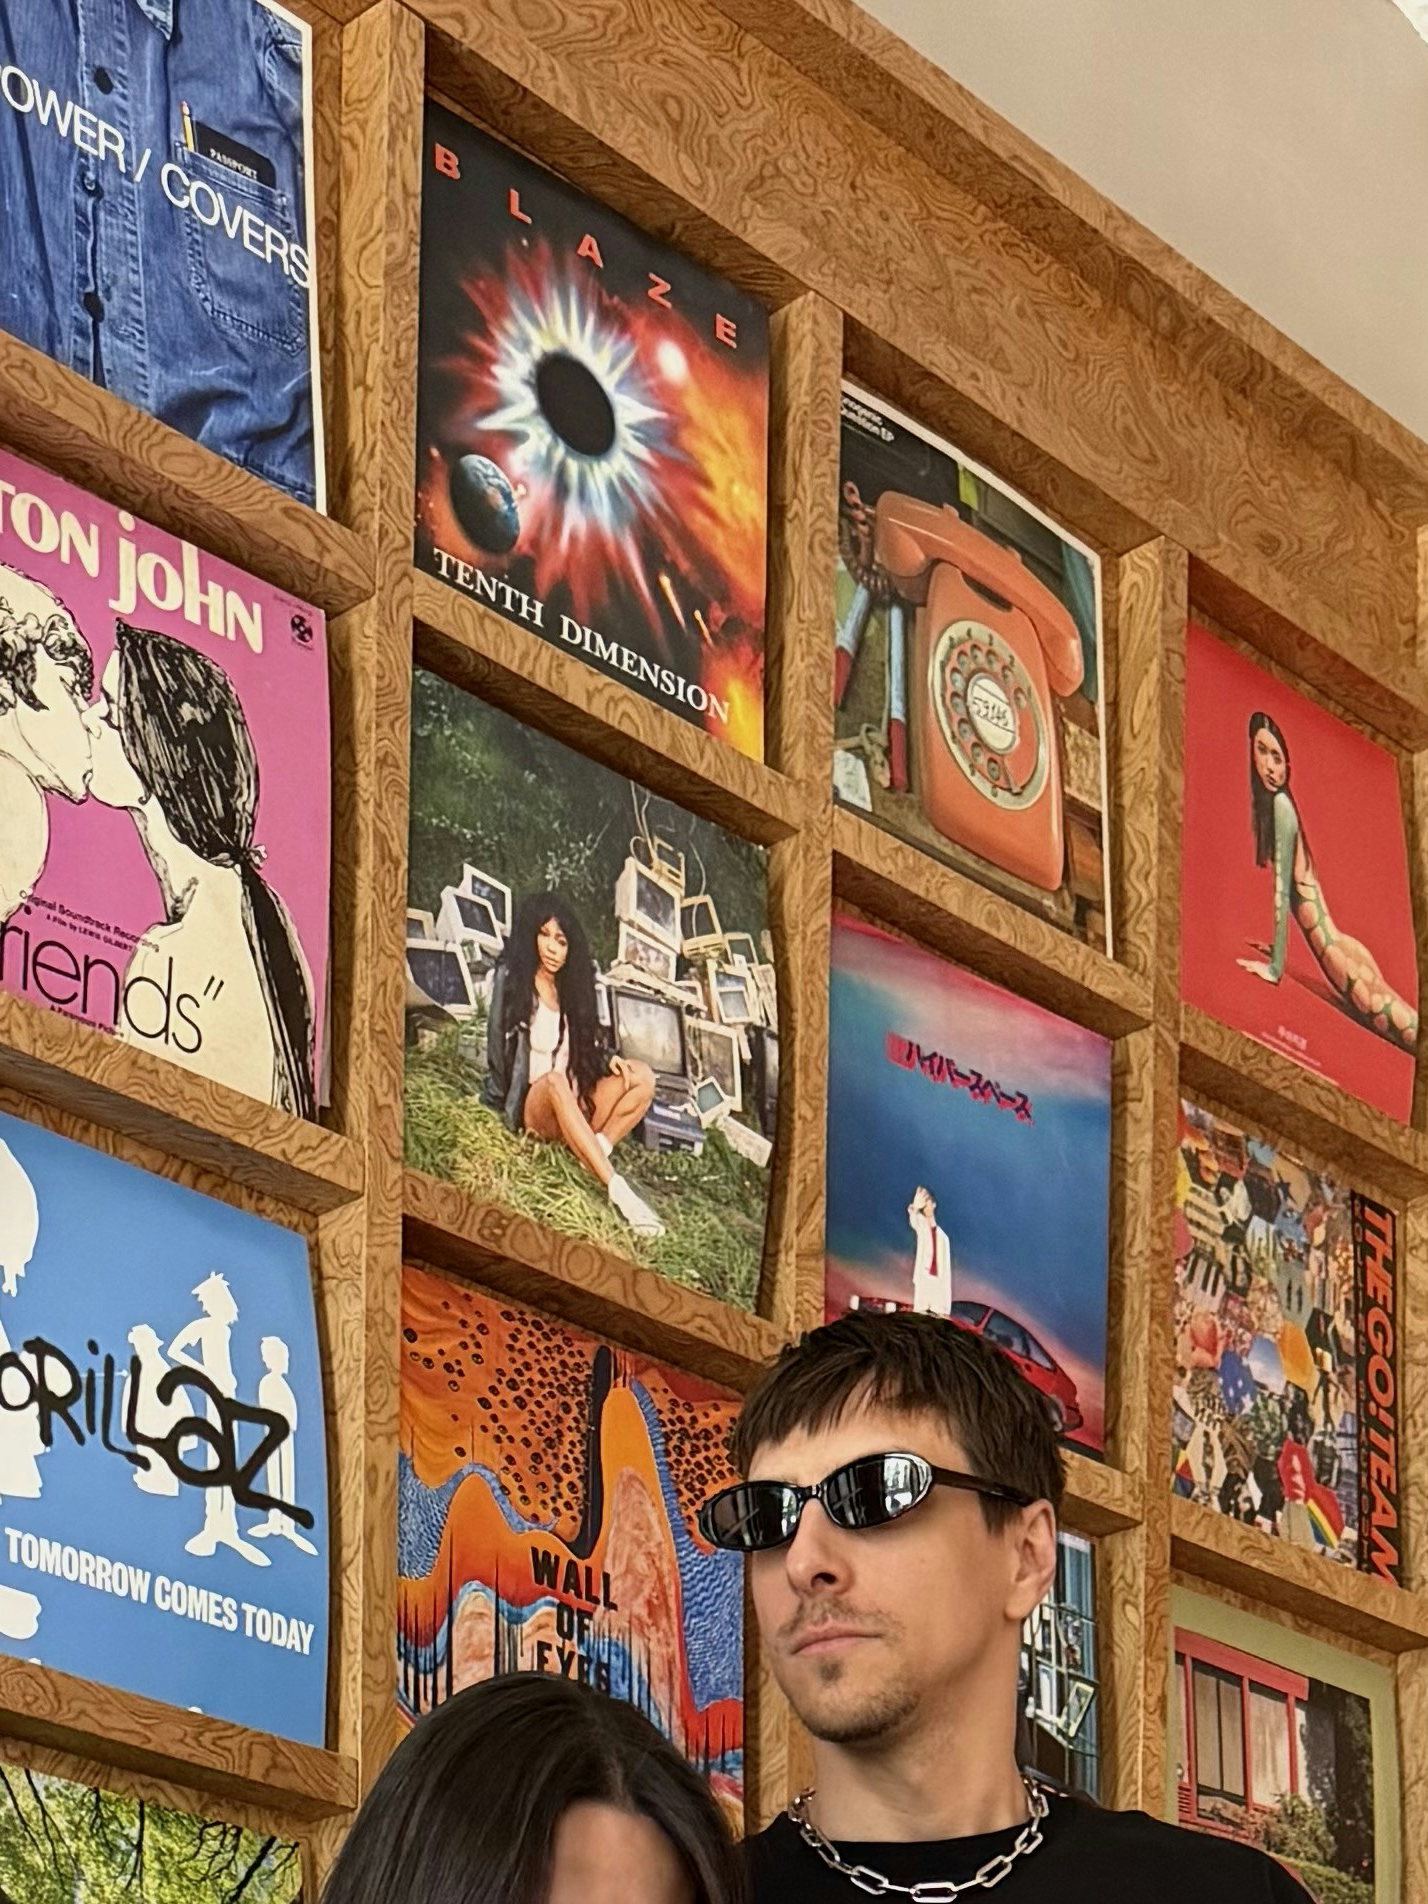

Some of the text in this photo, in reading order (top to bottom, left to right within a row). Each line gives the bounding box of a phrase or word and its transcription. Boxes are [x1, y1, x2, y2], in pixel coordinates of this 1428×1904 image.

[160, 163, 311, 290] COVERS
[433, 547, 731, 725] TENTH DIMENSION
[5, 1526, 315, 1656] TOMORROW COMES TODAY
[530, 1546, 618, 1611] WALL
[556, 1600, 595, 1646] OF
